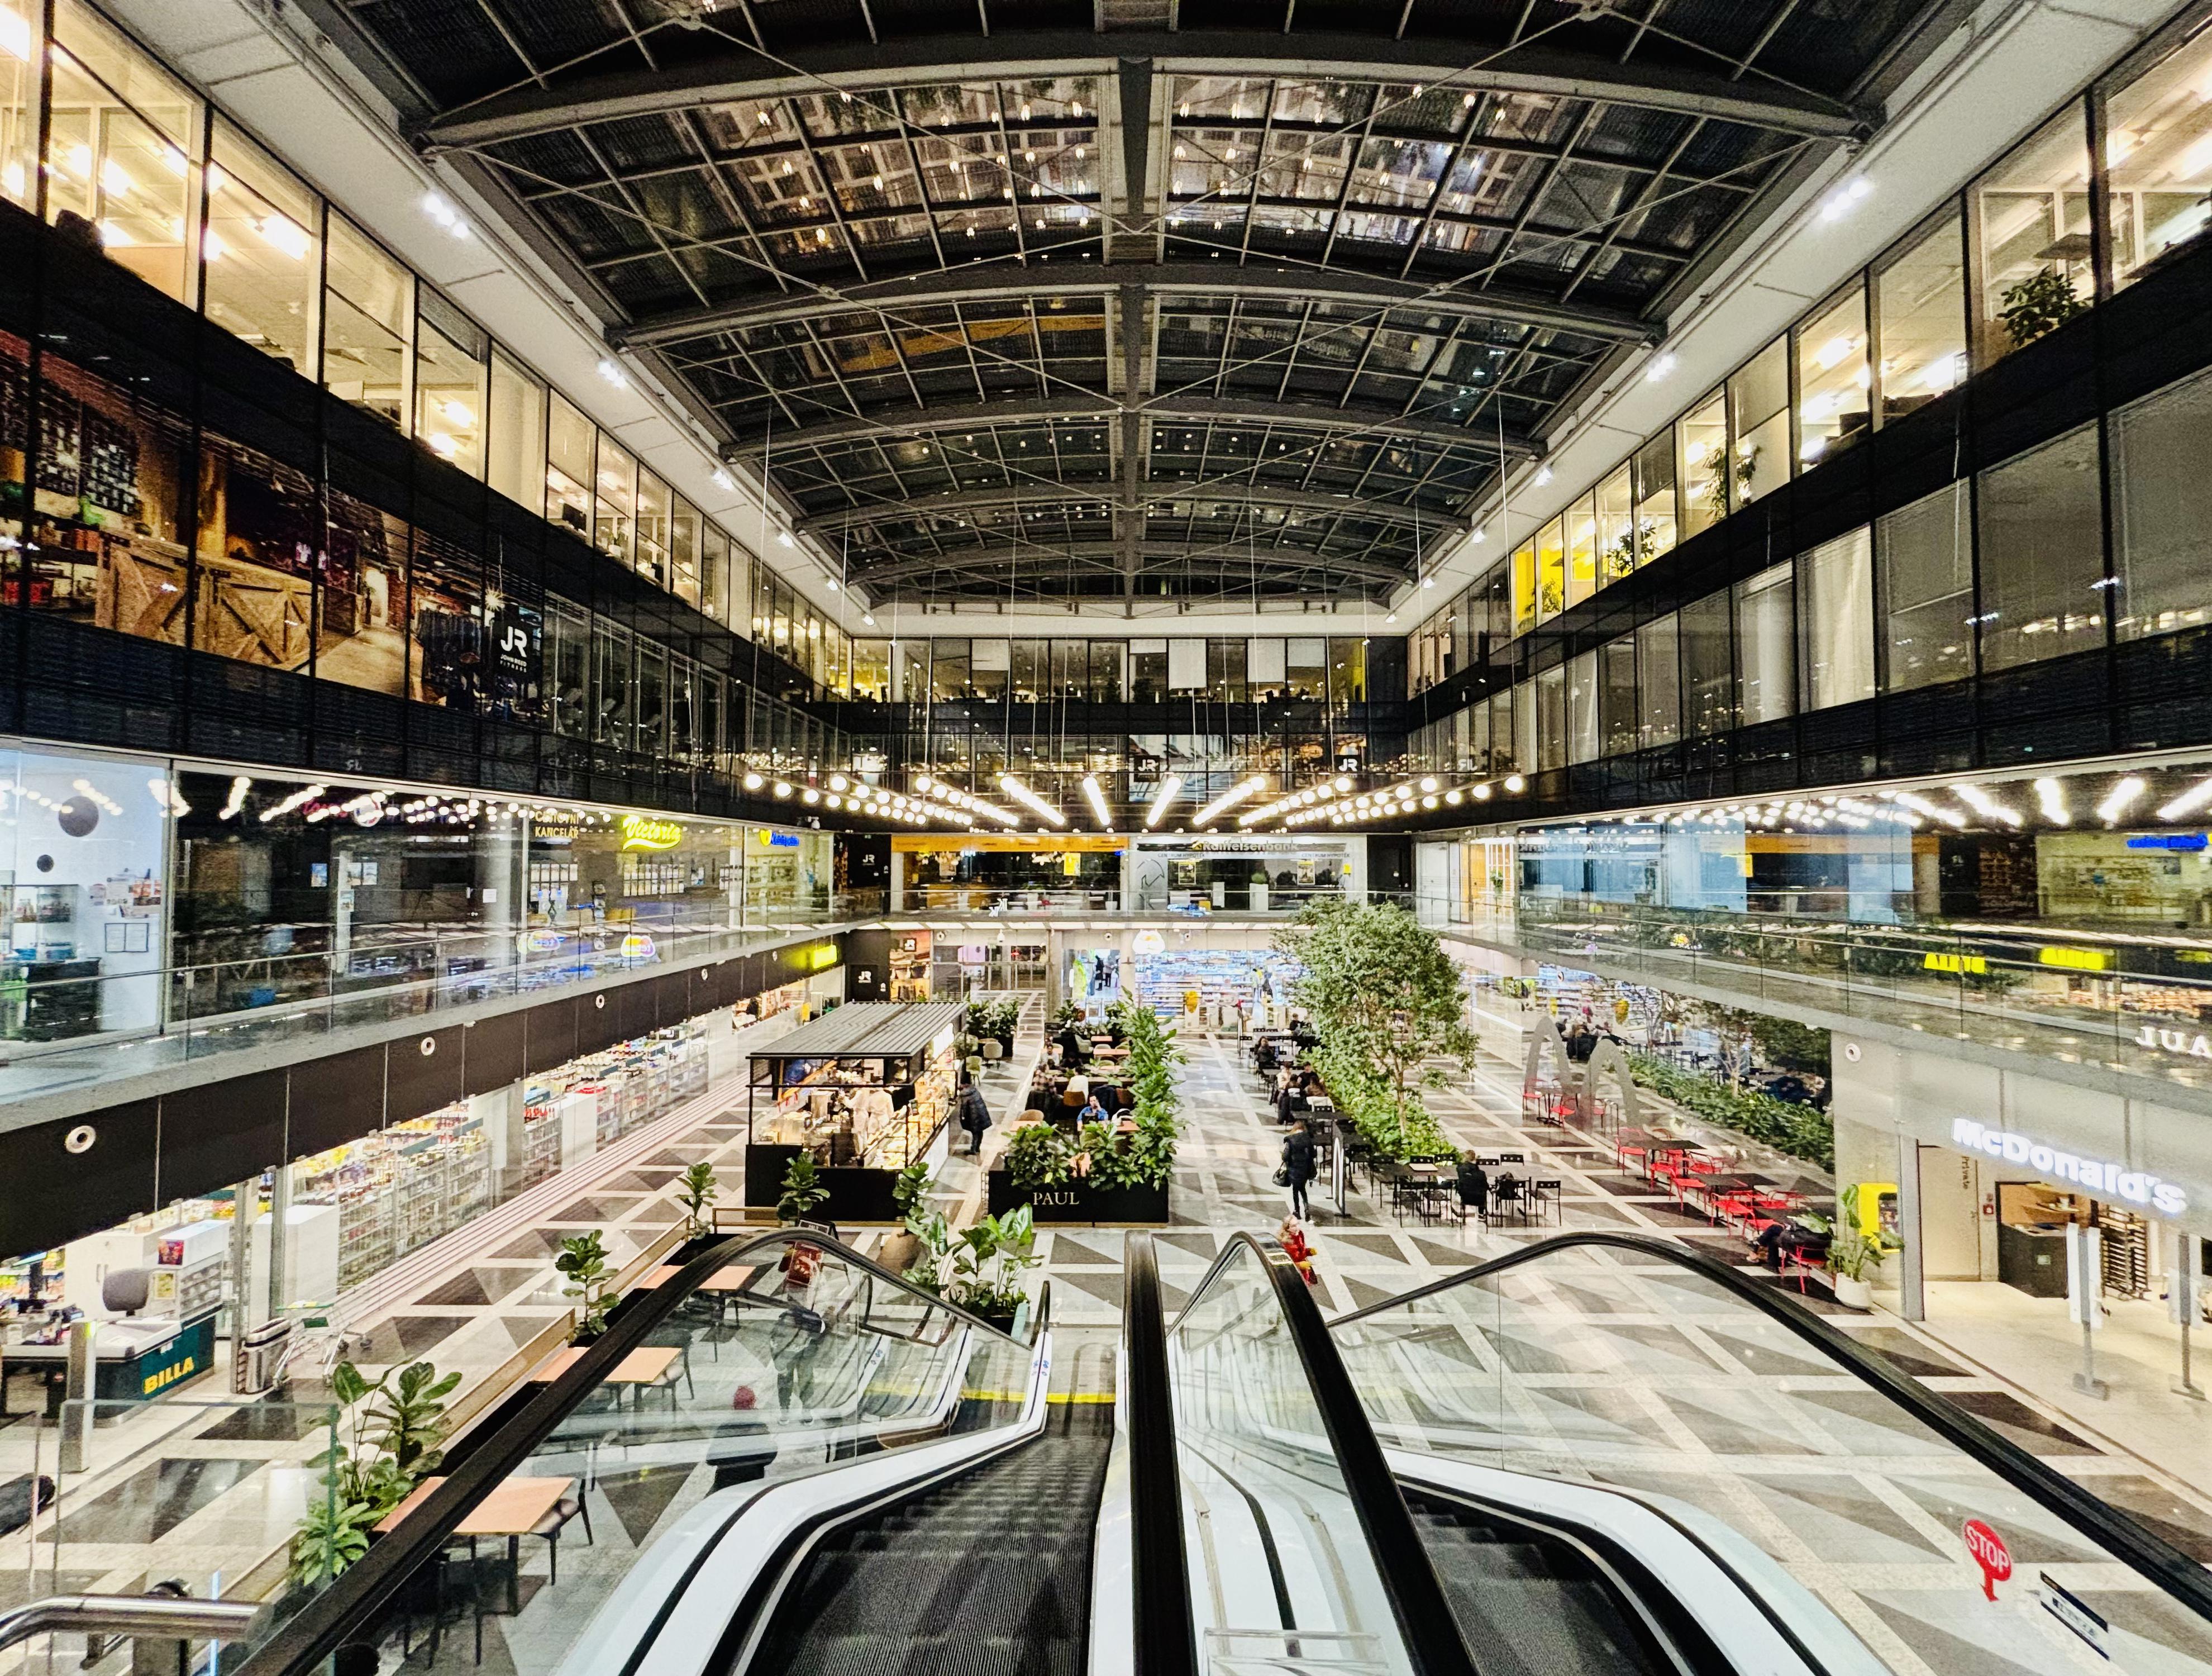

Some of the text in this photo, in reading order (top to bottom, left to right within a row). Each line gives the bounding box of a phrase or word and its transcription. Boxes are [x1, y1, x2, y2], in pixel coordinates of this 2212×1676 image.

[500, 626, 527, 658] JR
[1138, 759, 1156, 772] JR
[1338, 758, 1358, 772] JR
[862, 854, 875, 863] JR
[858, 971, 871, 980] JR
[1953, 1118, 2187, 1213] McDonald's
[1033, 1192, 1080, 1205] PAUL
[144, 1356, 194, 1394] BILLA
[1966, 1525, 2009, 1573] STOP
